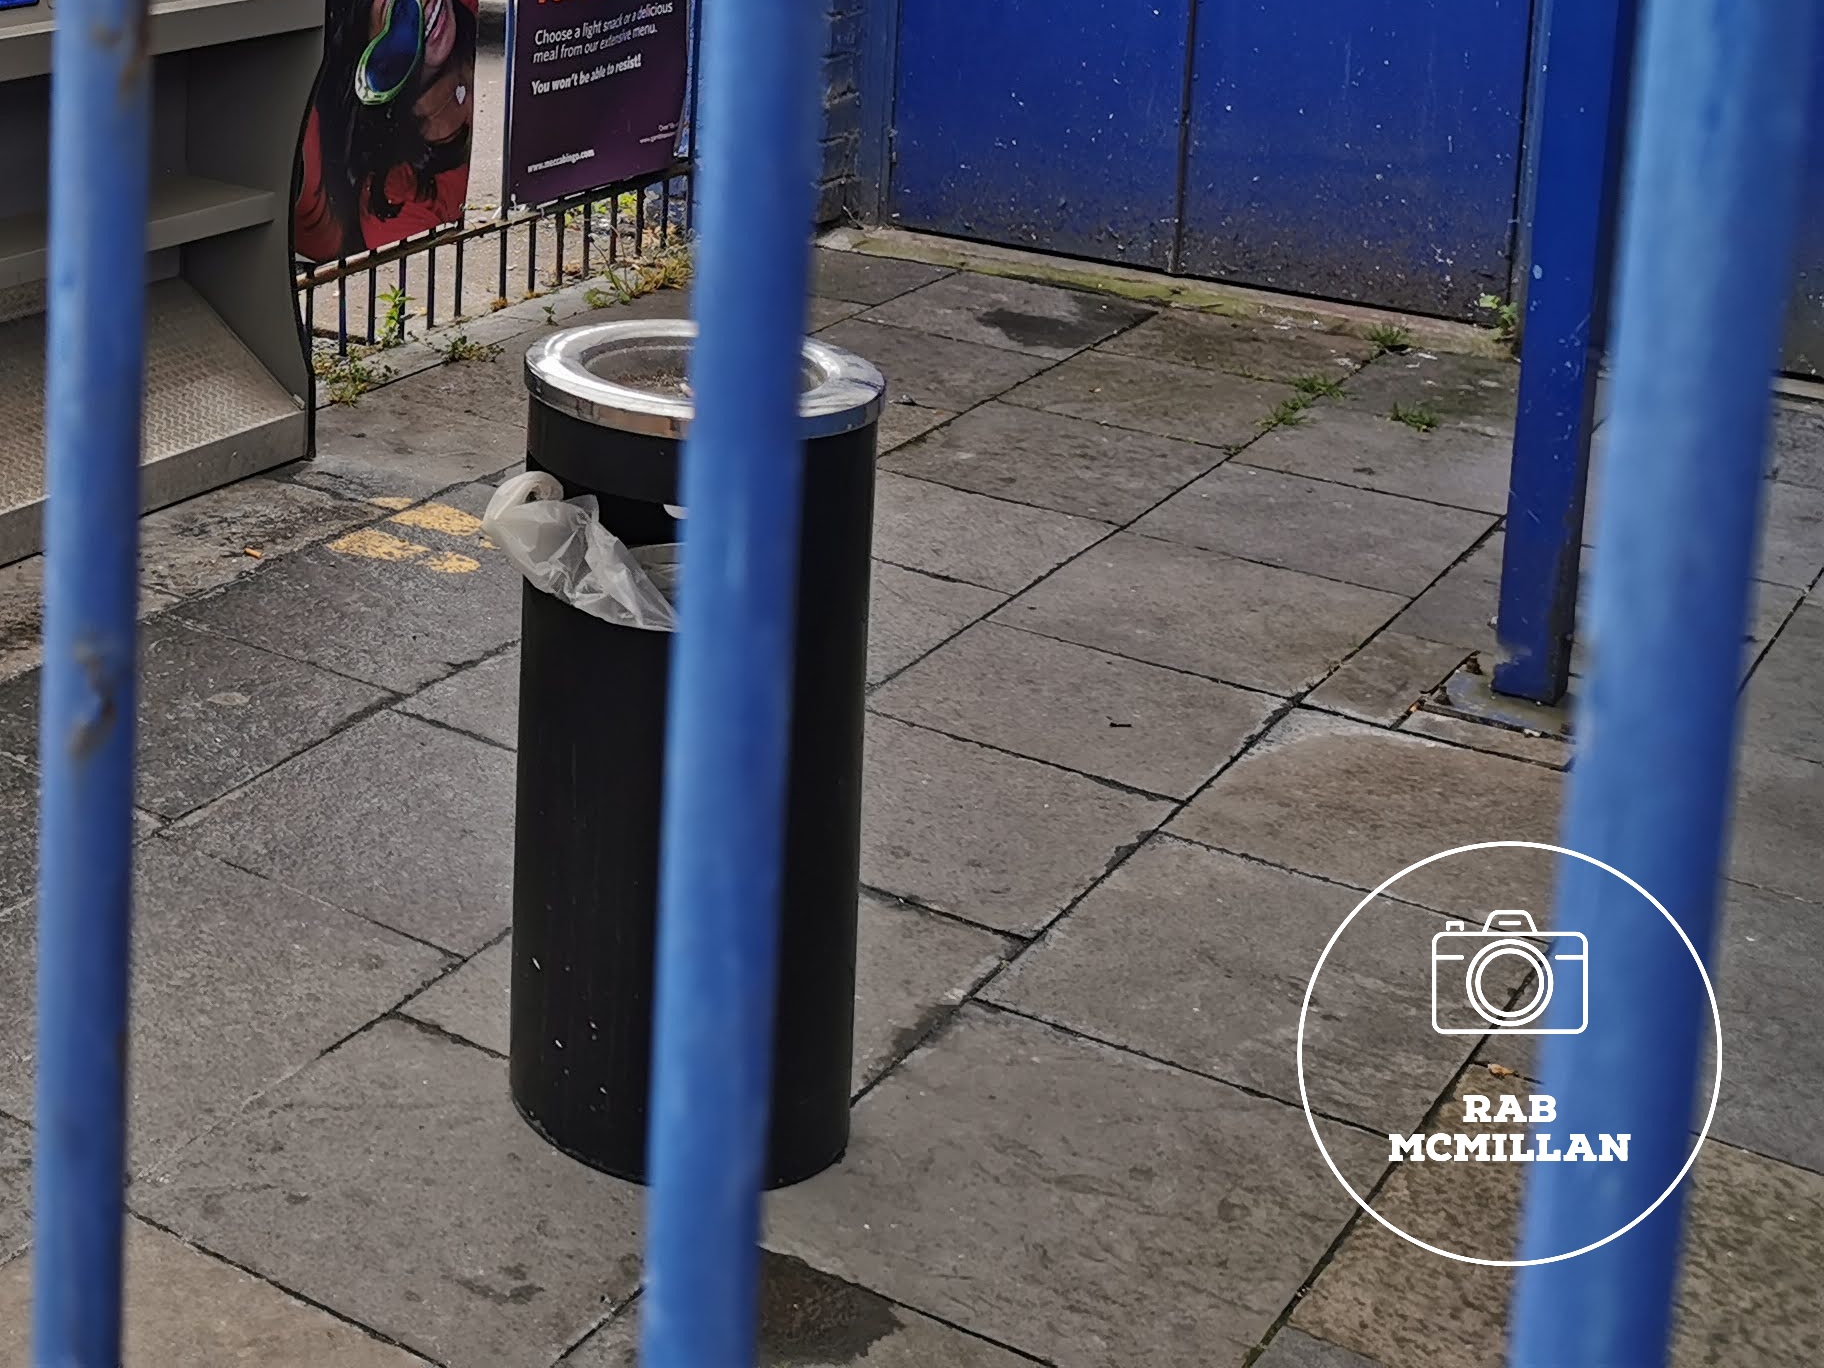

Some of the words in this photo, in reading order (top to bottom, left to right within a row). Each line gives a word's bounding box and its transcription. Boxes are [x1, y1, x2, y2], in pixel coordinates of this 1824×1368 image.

[533, 44, 558, 63] meal
[560, 43, 583, 59] from
[584, 39, 599, 54] our
[599, 29, 631, 50] extensive
[632, 22, 658, 38] menu.
[535, 28, 573, 45] Choose
[574, 27, 580, 38] a
[582, 20, 602, 39] light
[602, 14, 624, 32] snack
[623, 13, 631, 25] or
[631, 12, 636, 22] a
[636, 1, 673, 20] delicious
[531, 79, 550, 95] You
[551, 72, 578, 91] won't
[579, 70, 590, 85] be
[590, 65, 606, 82] able
[606, 63, 615, 76] to
[615, 53, 642, 73] resist!
